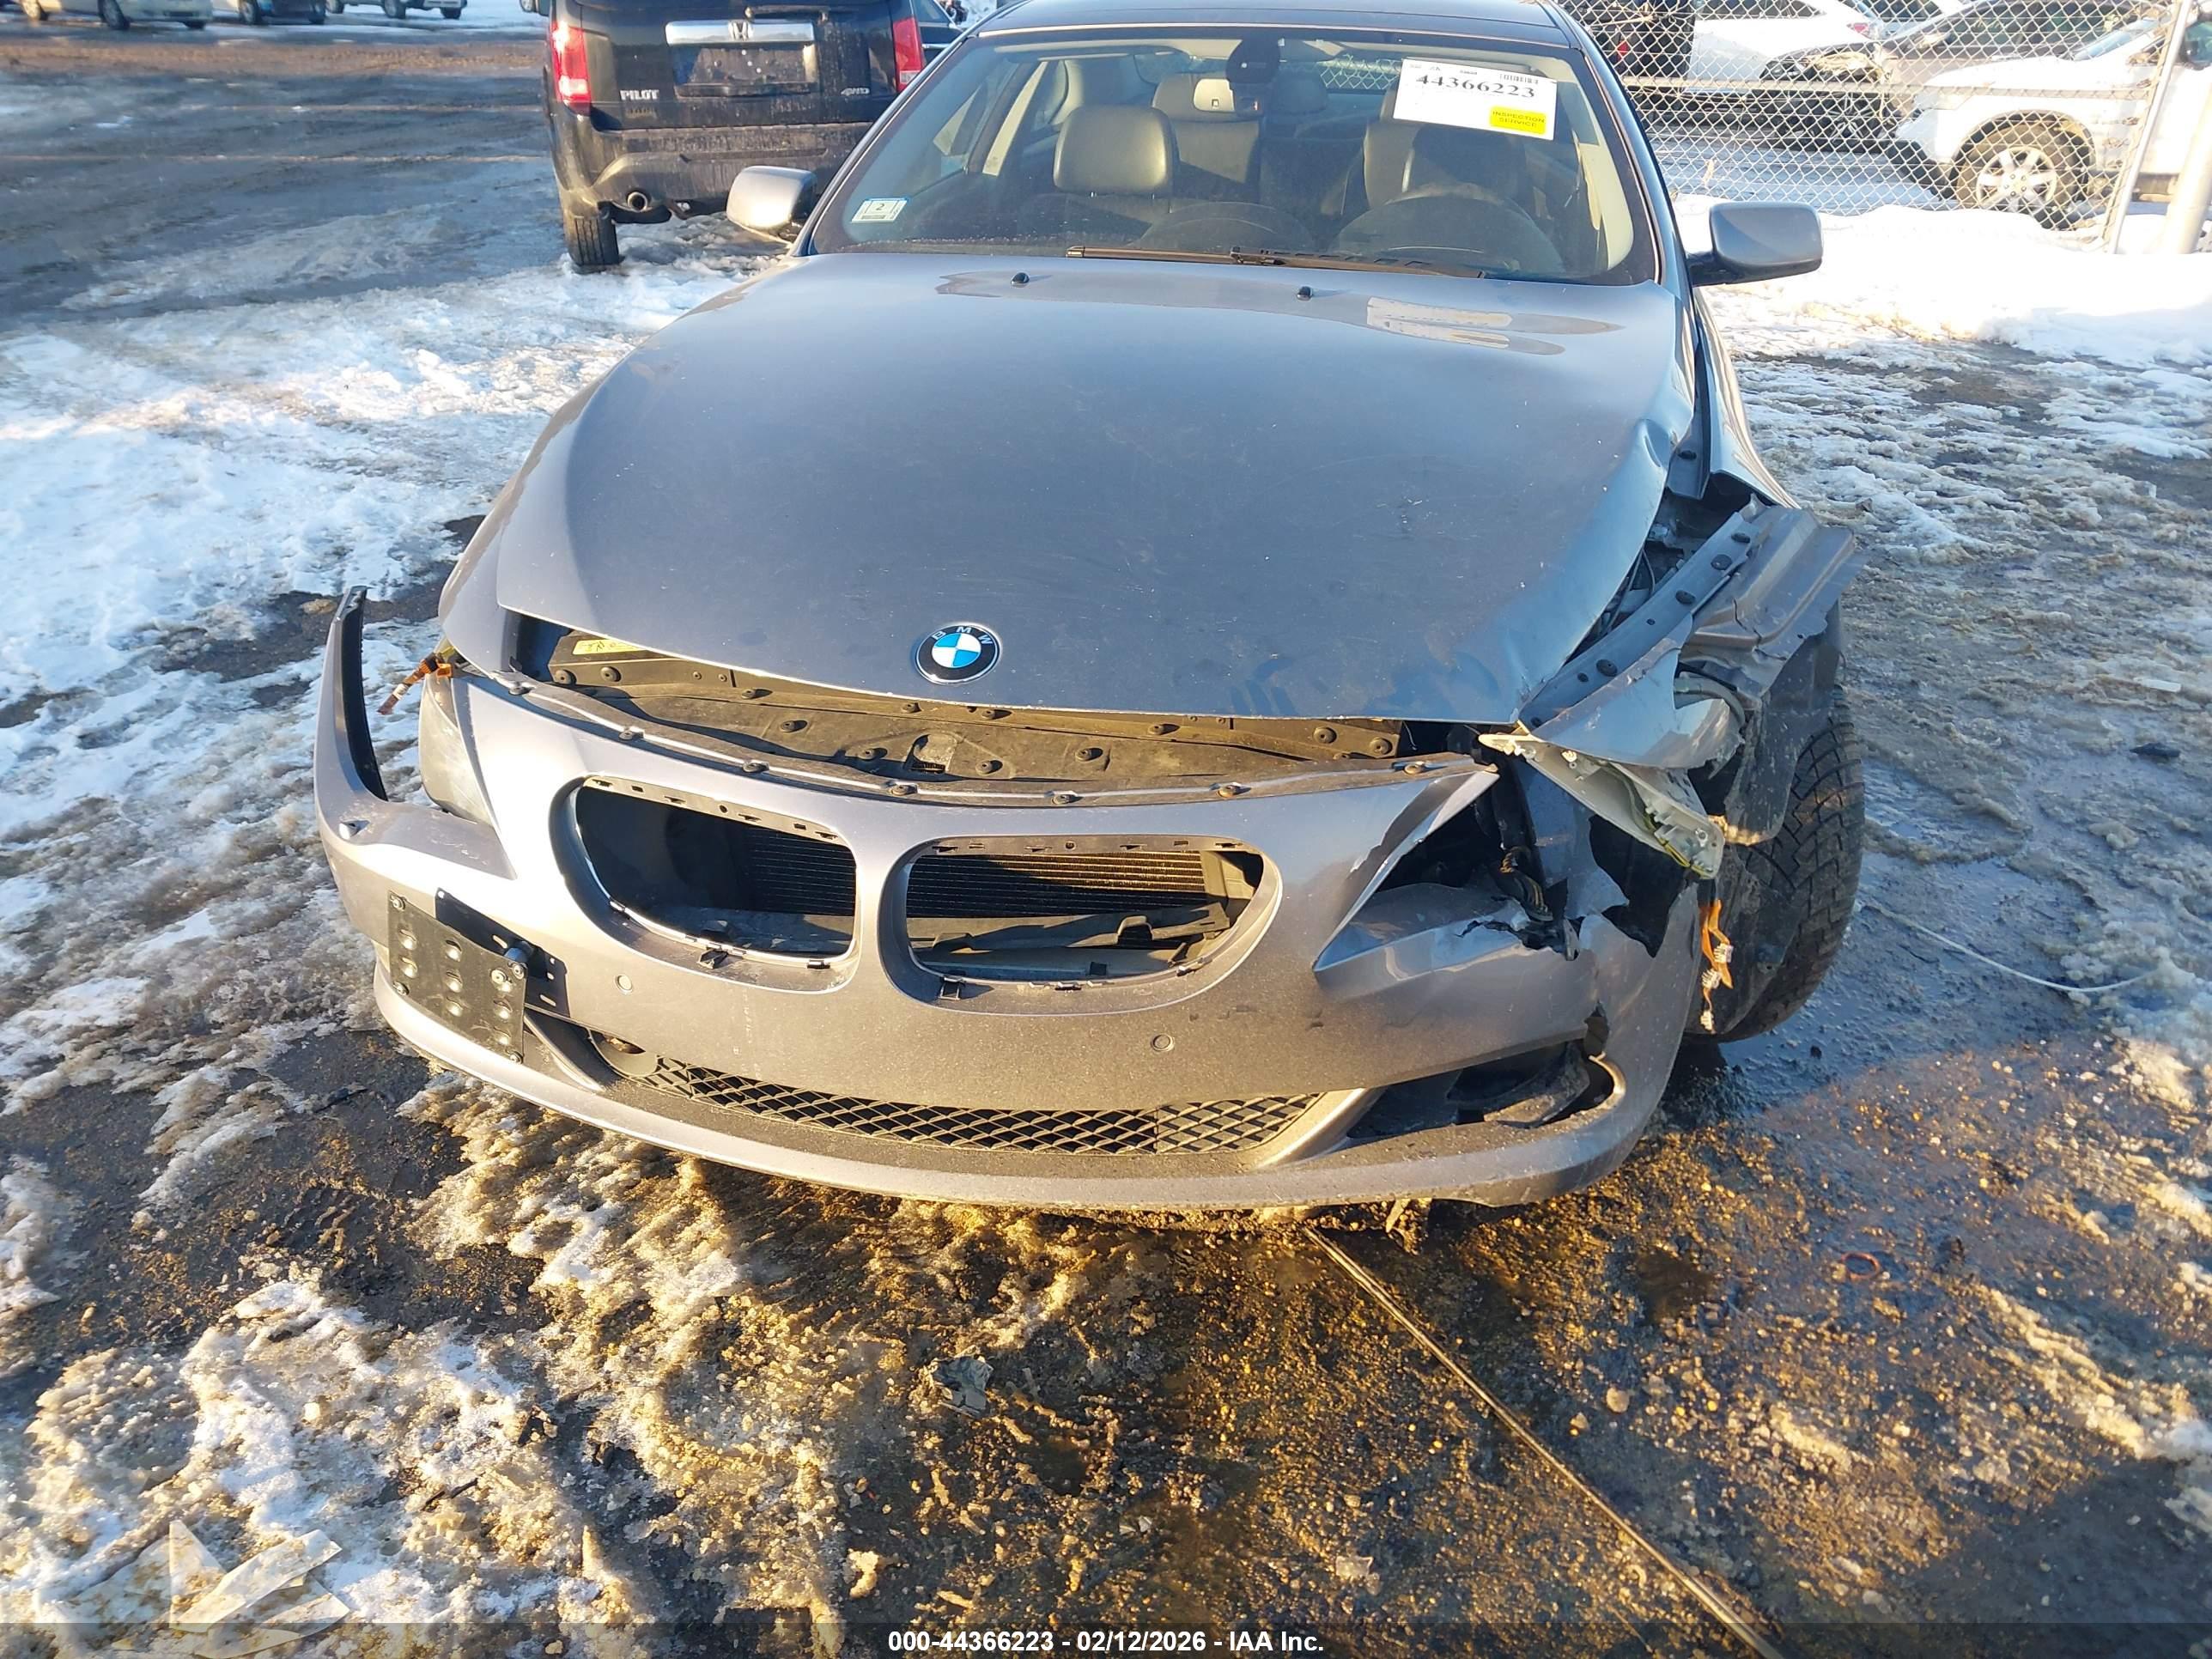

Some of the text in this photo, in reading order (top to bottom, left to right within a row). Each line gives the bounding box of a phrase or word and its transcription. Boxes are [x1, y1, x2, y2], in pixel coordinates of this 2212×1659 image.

[841, 87, 870, 96] 4WD
[1416, 75, 1535, 97] 44366223
[620, 89, 659, 100] PILOT
[932, 626, 994, 644] BMW
